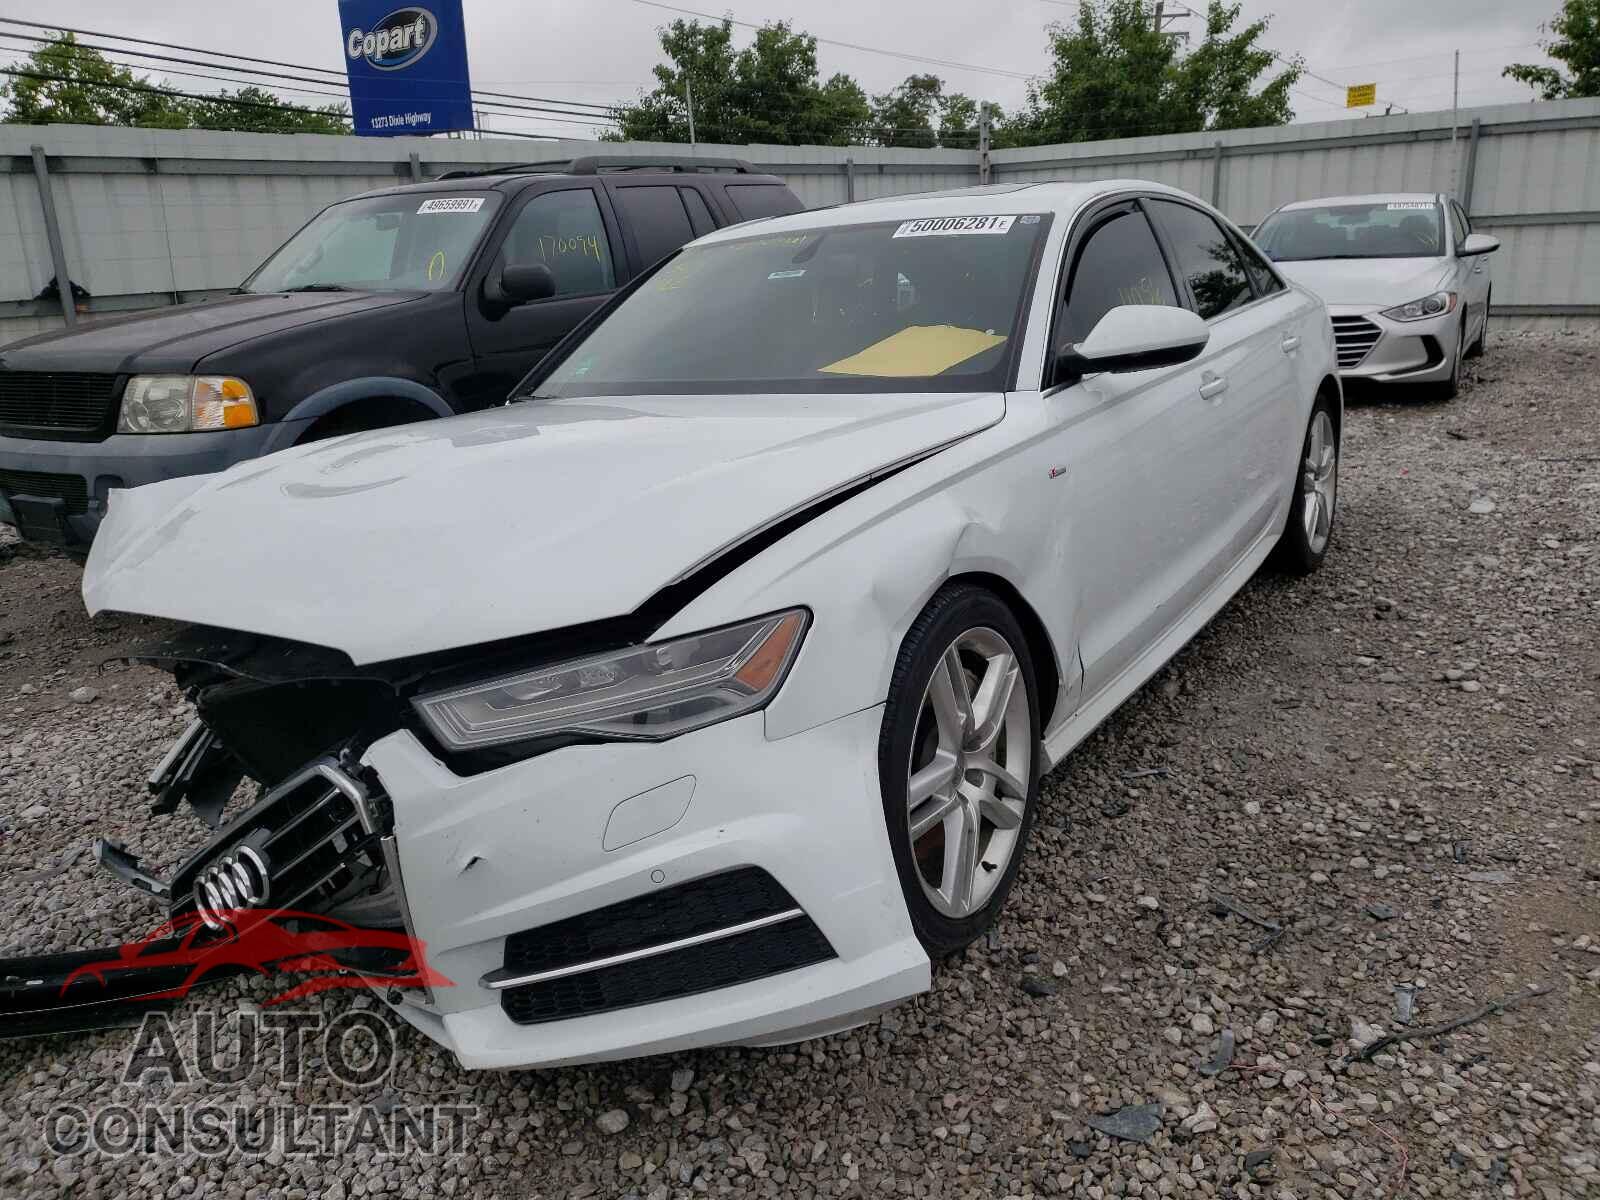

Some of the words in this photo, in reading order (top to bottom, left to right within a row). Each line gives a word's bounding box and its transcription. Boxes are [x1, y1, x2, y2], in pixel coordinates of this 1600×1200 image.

[348, 15, 424, 61] Copart
[372, 117, 388, 128] 13273
[389, 115, 404, 126] Dixie
[405, 112, 431, 126] Highway
[910, 216, 998, 232] 50006281
